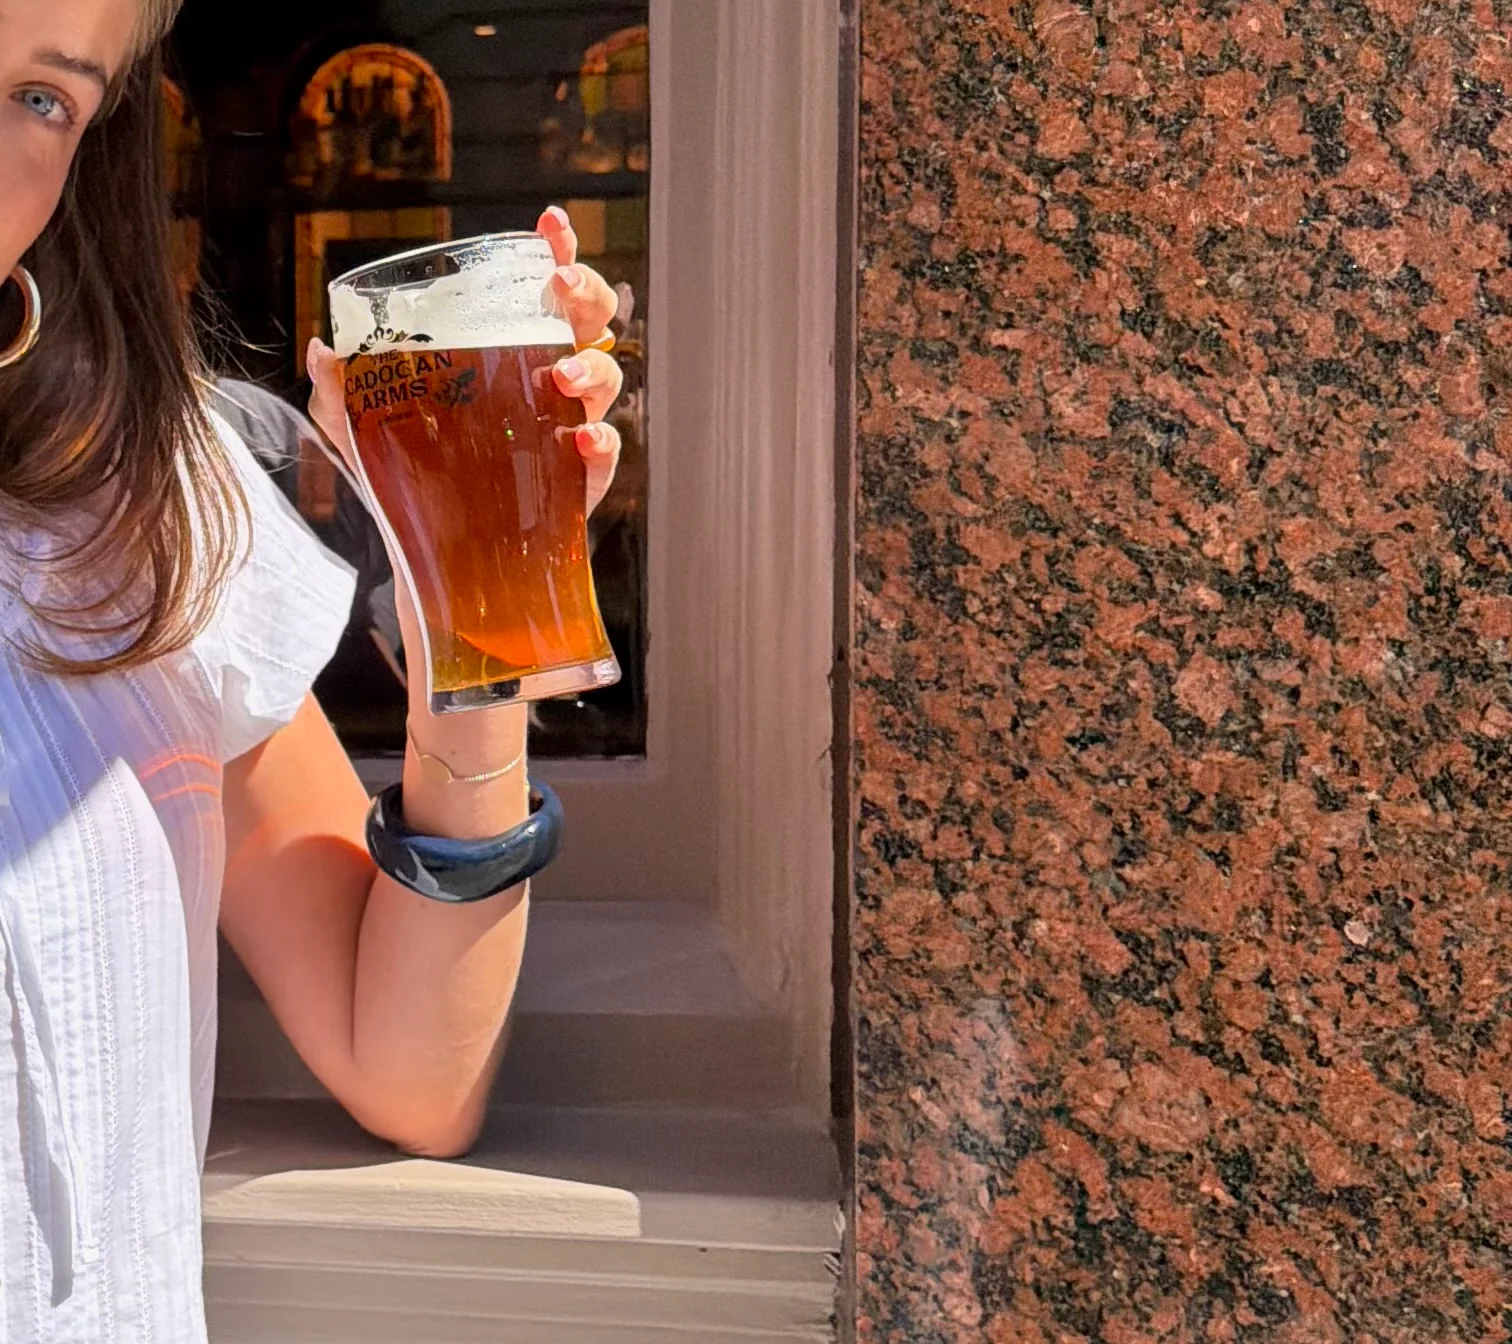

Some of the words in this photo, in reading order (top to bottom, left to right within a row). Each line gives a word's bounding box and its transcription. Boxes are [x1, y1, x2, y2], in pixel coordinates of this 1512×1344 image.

[345, 350, 452, 395] CADOGAN
[369, 349, 398, 365] THE
[362, 378, 428, 413] ARMS
